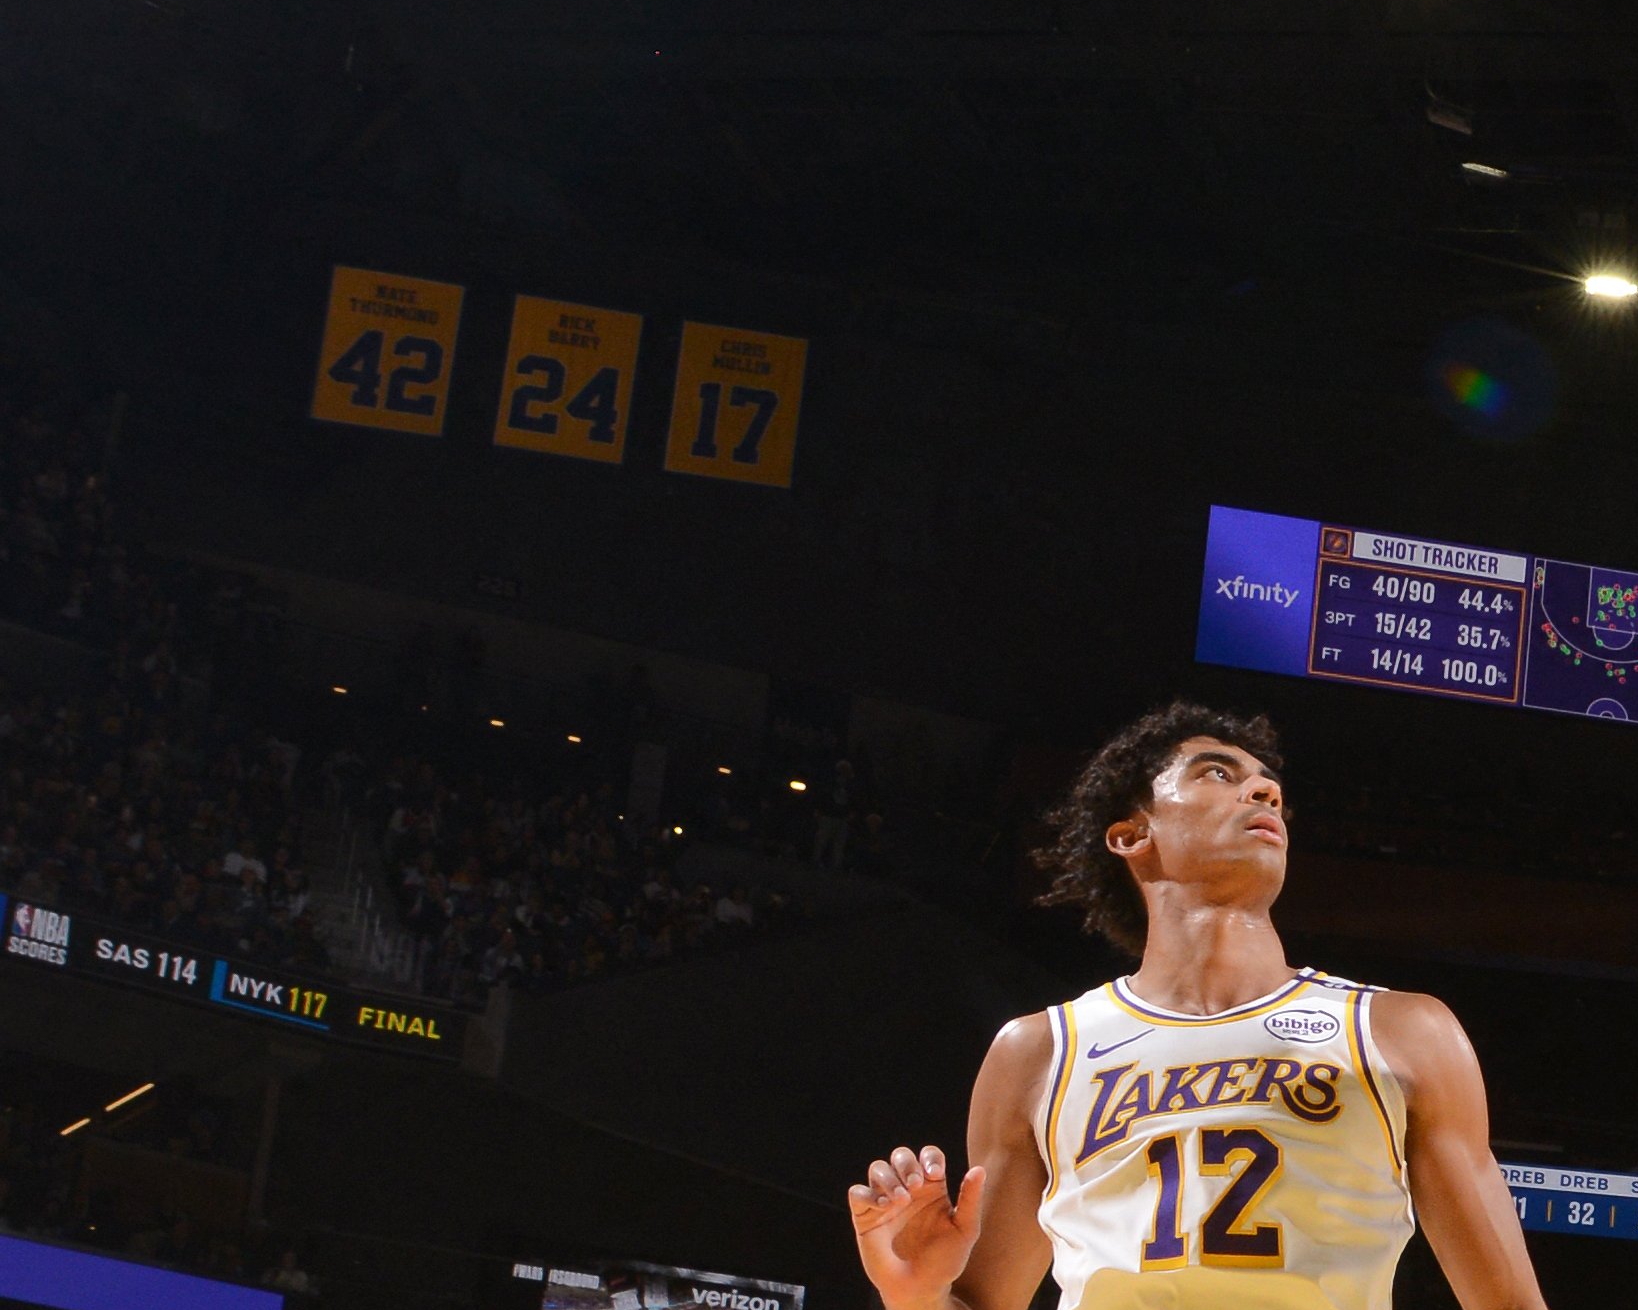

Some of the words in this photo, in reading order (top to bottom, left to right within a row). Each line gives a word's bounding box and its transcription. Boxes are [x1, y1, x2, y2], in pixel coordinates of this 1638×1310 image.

[328, 329, 444, 417] 42
[507, 354, 620, 446] 24
[690, 382, 780, 466] 17
[1372, 539, 1417, 562] SHOT
[1422, 545, 1500, 576] TRACKER
[1216, 576, 1299, 608] xfinity
[1328, 574, 1351, 589] FG
[1372, 575, 1436, 605] 40/90
[1458, 589, 1514, 615] 44.4%
[1325, 612, 1356, 627] 3PT
[1375, 613, 1432, 641] 15/42
[1457, 625, 1511, 651] 35.7%
[1321, 647, 1343, 662] FT
[1371, 649, 1424, 676] 14/14
[1442, 658, 1508, 686] 100.0%
[30, 906, 71, 947] NBA
[8, 936, 68, 966] SCORES
[96, 938, 151, 969] SAS
[156, 952, 198, 986] 114
[230, 973, 284, 1006] NYK
[288, 987, 328, 1019] 117
[358, 1006, 442, 1040] FINAL
[1271, 1016, 1336, 1035] bibigo
[1074, 1056, 1346, 1172] LAKERS
[1141, 1126, 1285, 1272] 12
[1559, 1174, 1610, 1192] DREB
[1568, 1202, 1595, 1227] 32
